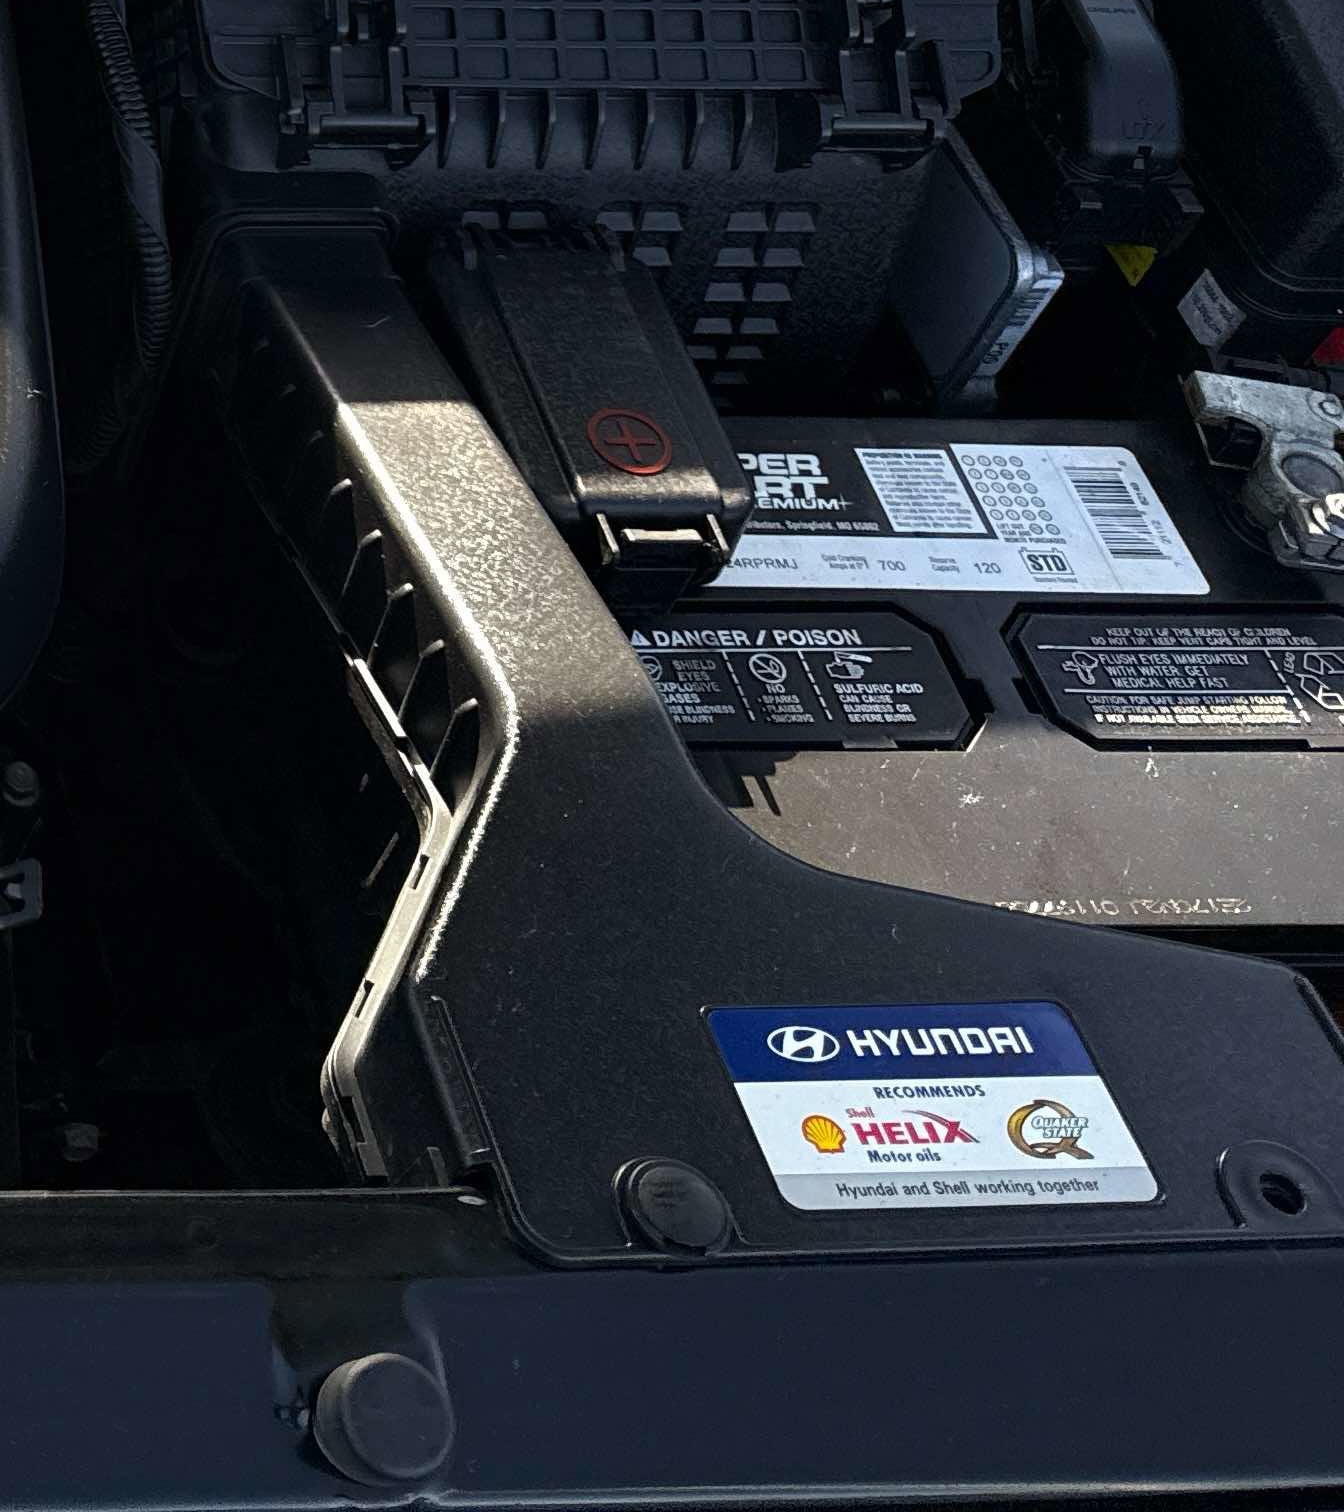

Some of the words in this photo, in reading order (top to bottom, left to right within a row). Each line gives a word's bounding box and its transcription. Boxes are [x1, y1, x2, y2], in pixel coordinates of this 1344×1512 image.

[736, 453, 822, 476] PER
[878, 560, 906, 571] 700
[974, 562, 1002, 574] 120
[1027, 553, 1068, 573] STD
[652, 630, 751, 646] DANGER
[775, 630, 862, 646] POISON
[672, 660, 716, 670] SHIELD
[1097, 654, 1138, 665] FLUSH
[1138, 654, 1171, 665] EYES
[1171, 654, 1249, 665] IMMEDIATELY
[676, 671, 710, 681] EYES
[1104, 666, 1137, 676] WITH
[1184, 666, 1209, 676] GET
[766, 684, 785, 693] NO
[1112, 677, 1164, 688] MEDICAL
[1165, 677, 1196, 688] HELP
[1199, 677, 1229, 688] FAST
[833, 684, 893, 694] SULFURIC
[896, 684, 923, 694] ACID
[847, 1026, 1035, 1057] HYUNDAI
[873, 1085, 986, 1099] RECOMMENDS
[845, 1107, 875, 1119] Shell
[1031, 1115, 1089, 1130] QUAKER
[851, 1120, 980, 1145] HELIX
[1041, 1126, 1084, 1139] STATE
[866, 1149, 913, 1163] Motor
[915, 1148, 942, 1162] oils
[836, 1182, 897, 1198] Hyundai
[903, 1182, 930, 1195] and
[932, 1180, 971, 1195] Shell
[974, 1180, 1035, 1197] working
[1037, 1178, 1100, 1194] together
